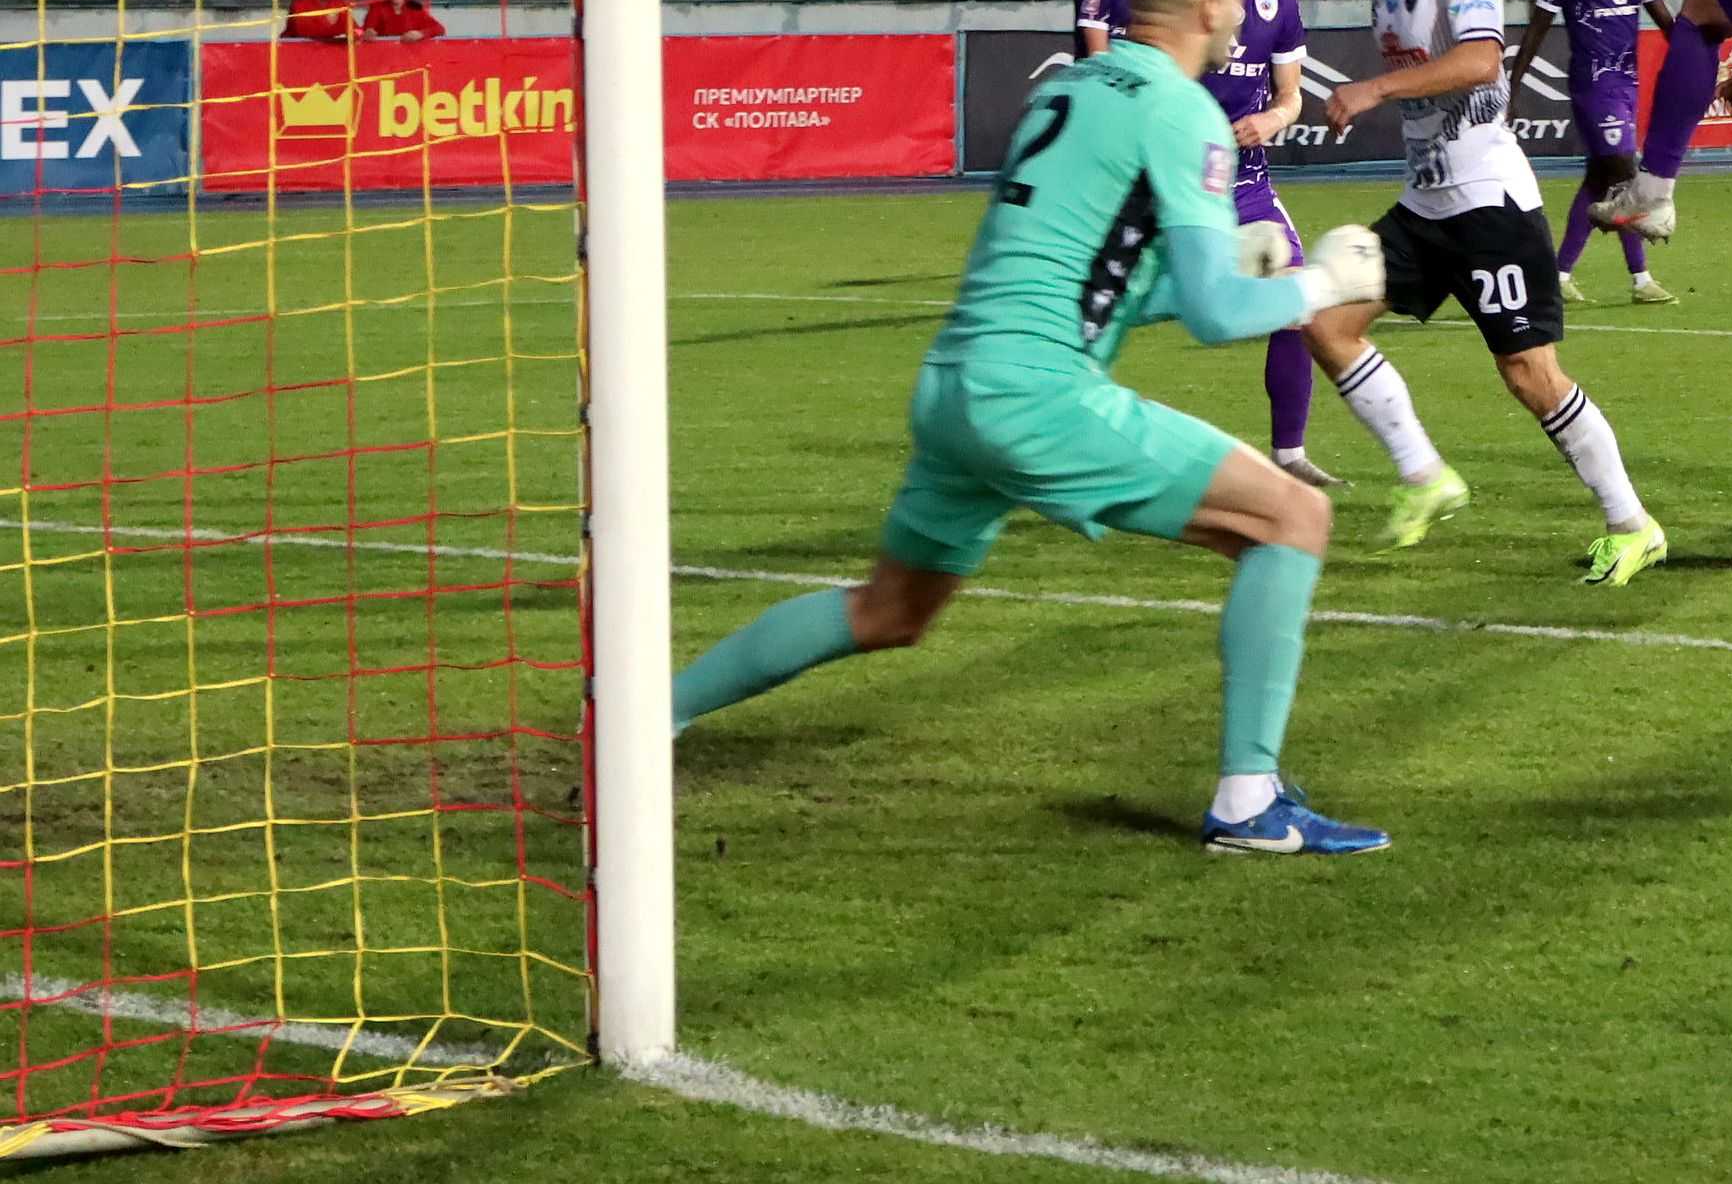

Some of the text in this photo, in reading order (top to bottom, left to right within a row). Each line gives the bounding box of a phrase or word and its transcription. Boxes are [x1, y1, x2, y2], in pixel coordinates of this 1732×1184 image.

[378, 76, 578, 138] betkin
[693, 86, 863, 106] ПРЕМІУМПАРТНЕР
[692, 111, 832, 130] СК «ПОЛТАВА»
[1471, 263, 1528, 314] 20
